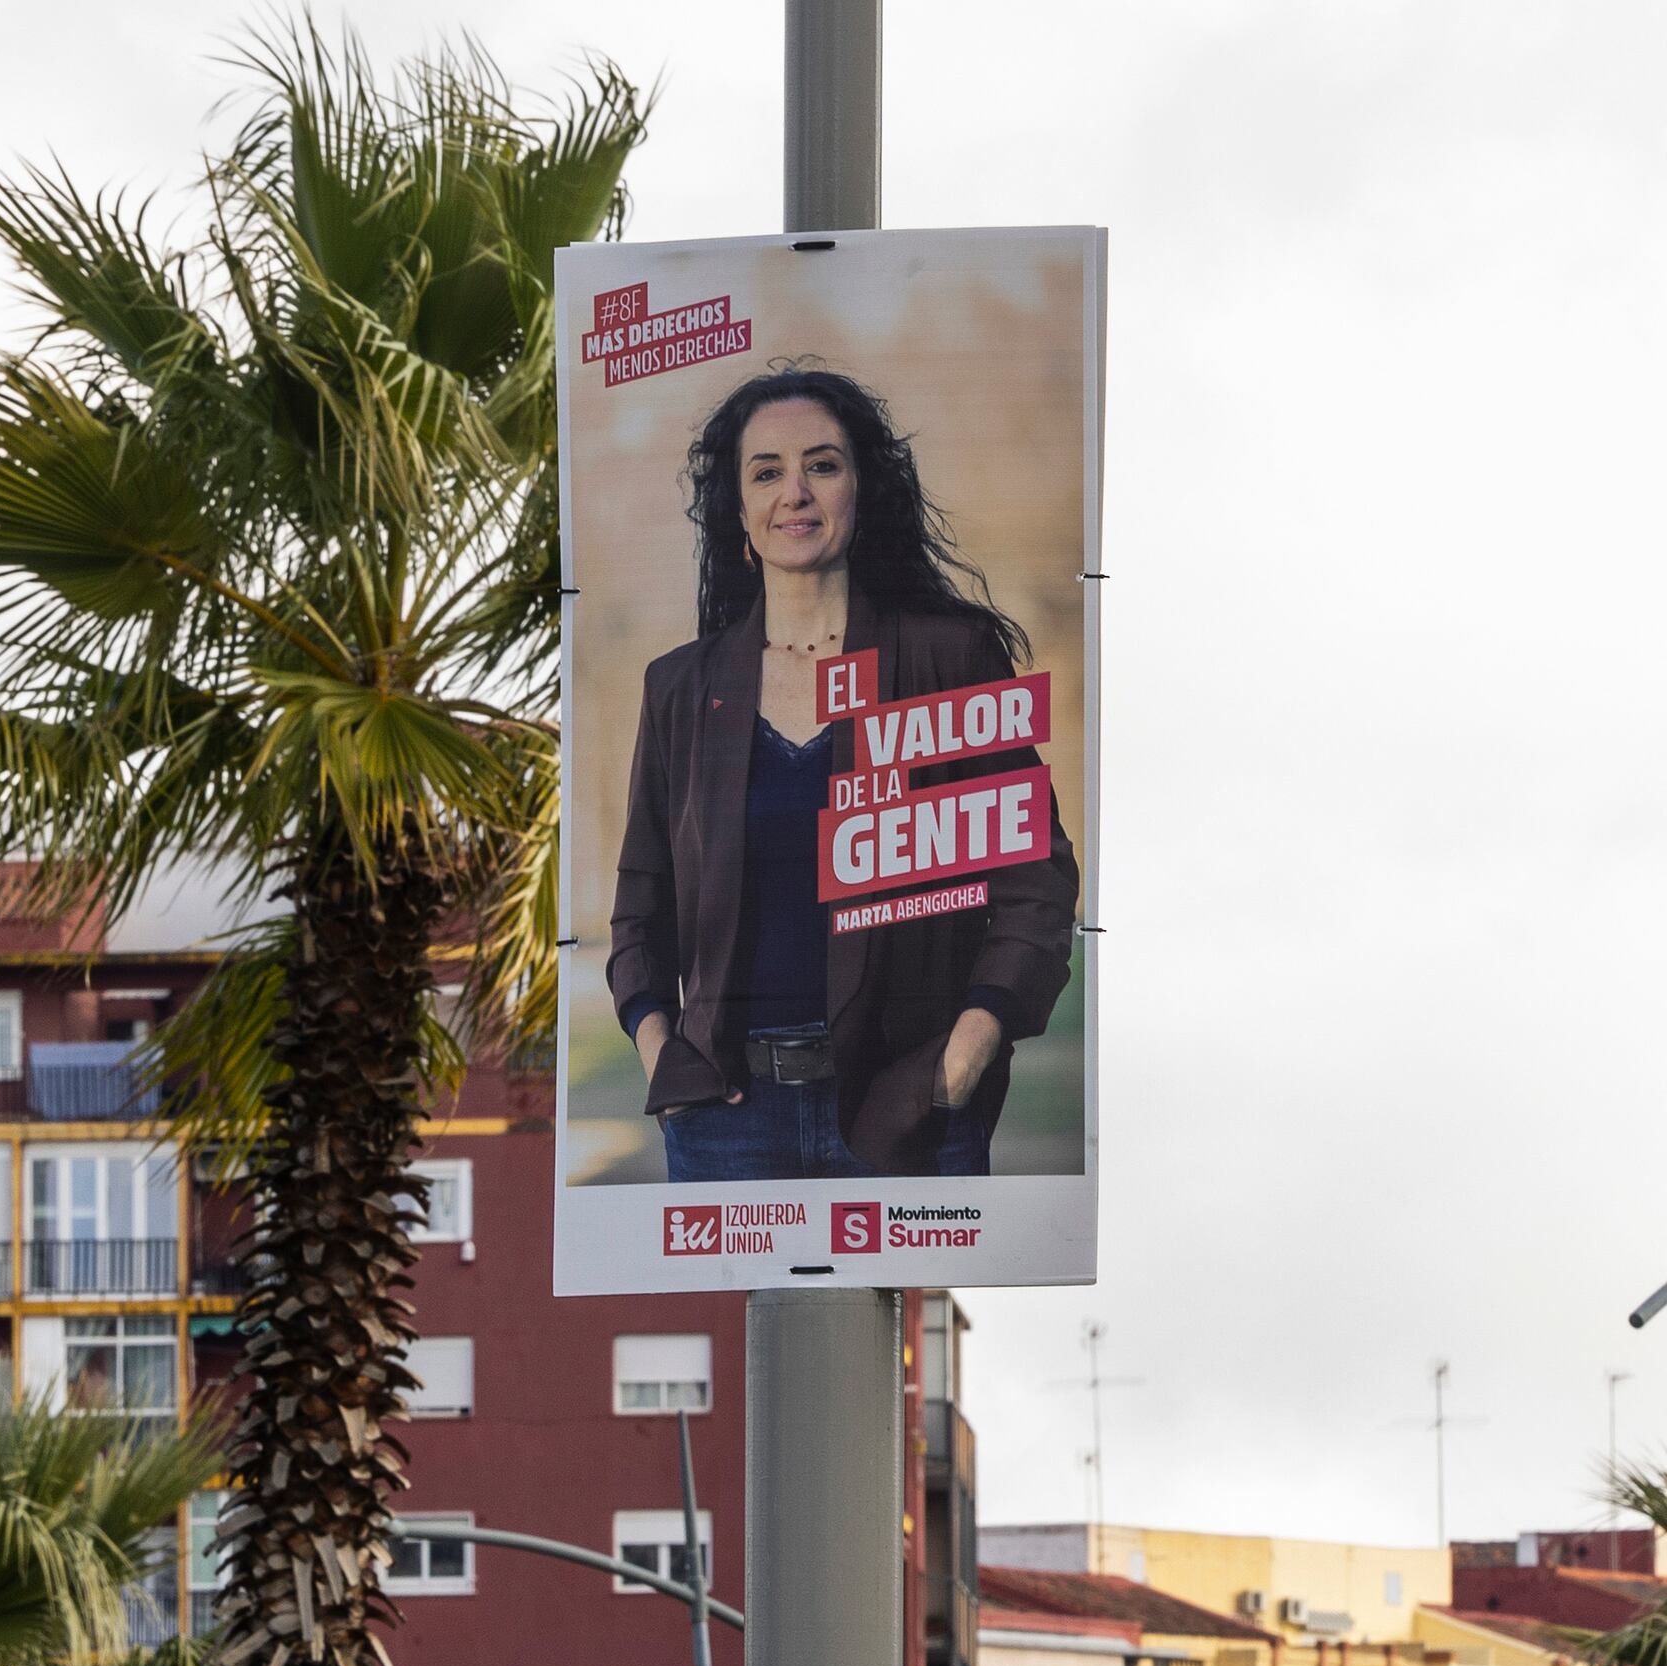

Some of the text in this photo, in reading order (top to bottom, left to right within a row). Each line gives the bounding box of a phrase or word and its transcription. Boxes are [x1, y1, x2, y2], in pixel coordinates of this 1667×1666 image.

[586, 300, 725, 360] MÁS DERECHOS
[600, 289, 641, 327] #8F
[609, 325, 746, 383] MENOS DERECHAS
[827, 661, 867, 714] EL
[864, 687, 1034, 767] VALOR
[835, 769, 902, 812] DE LA
[832, 781, 1033, 885] GENTE
[836, 885, 986, 932] MARTA ABENGOCHEA
[726, 1203, 807, 1229] IZQUIERDA
[888, 1205, 981, 1221] Movimiento
[888, 1223, 981, 1248] Sumar
[726, 1231, 774, 1254] UNIDA
